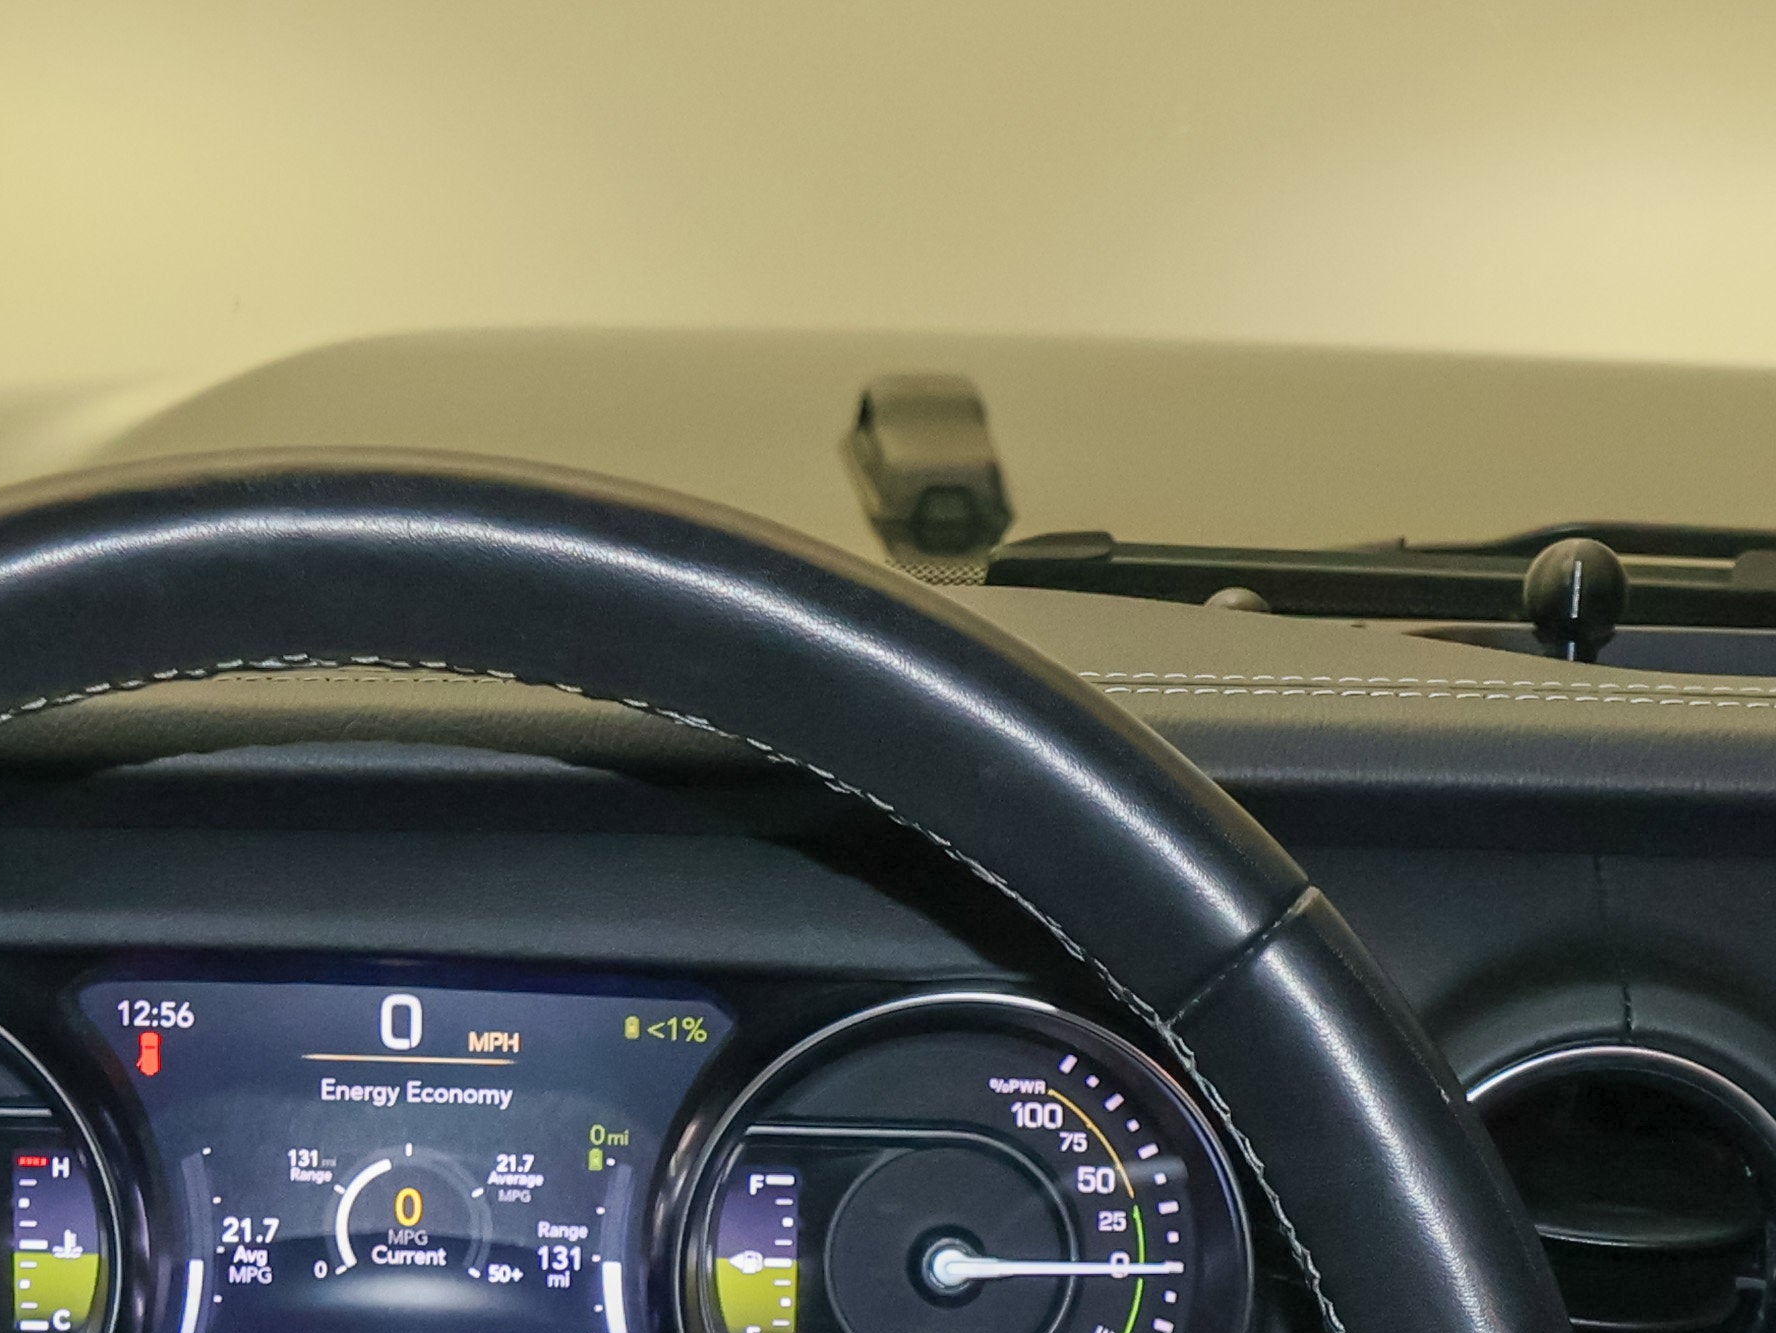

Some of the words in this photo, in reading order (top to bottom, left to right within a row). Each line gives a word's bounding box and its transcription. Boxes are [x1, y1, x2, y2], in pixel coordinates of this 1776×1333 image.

[117, 1001, 194, 1029] 12:56
[380, 994, 424, 1049] 0
[647, 1017, 708, 1043] <1%
[468, 1031, 520, 1053] MPH
[320, 1079, 399, 1106] Energy
[406, 1081, 513, 1108] Economy
[1010, 1103, 1063, 1129] 100
[590, 1125, 605, 1146] 0
[607, 1128, 629, 1146] mi
[1060, 1132, 1088, 1153] 75
[52, 1158, 70, 1178] H
[288, 1150, 318, 1169] 131
[496, 1155, 534, 1173] 21.7
[290, 1167, 332, 1184] Range
[487, 1171, 543, 1189] Average
[749, 1175, 765, 1195] F
[1077, 1167, 1116, 1193] 50
[498, 1188, 531, 1203] MPG
[394, 1187, 423, 1226] 0
[222, 1218, 279, 1244] 21.7
[1098, 1211, 1127, 1231] 25
[388, 1229, 428, 1247] MPG
[537, 1222, 588, 1242] Range
[234, 1247, 268, 1268] Avg
[371, 1246, 446, 1267] Current
[537, 1247, 582, 1270] 131
[229, 1267, 273, 1285] MPG
[314, 1261, 327, 1279] 0
[487, 1265, 524, 1283] 50+
[547, 1270, 570, 1288] mi
[52, 1311, 72, 1331] C
